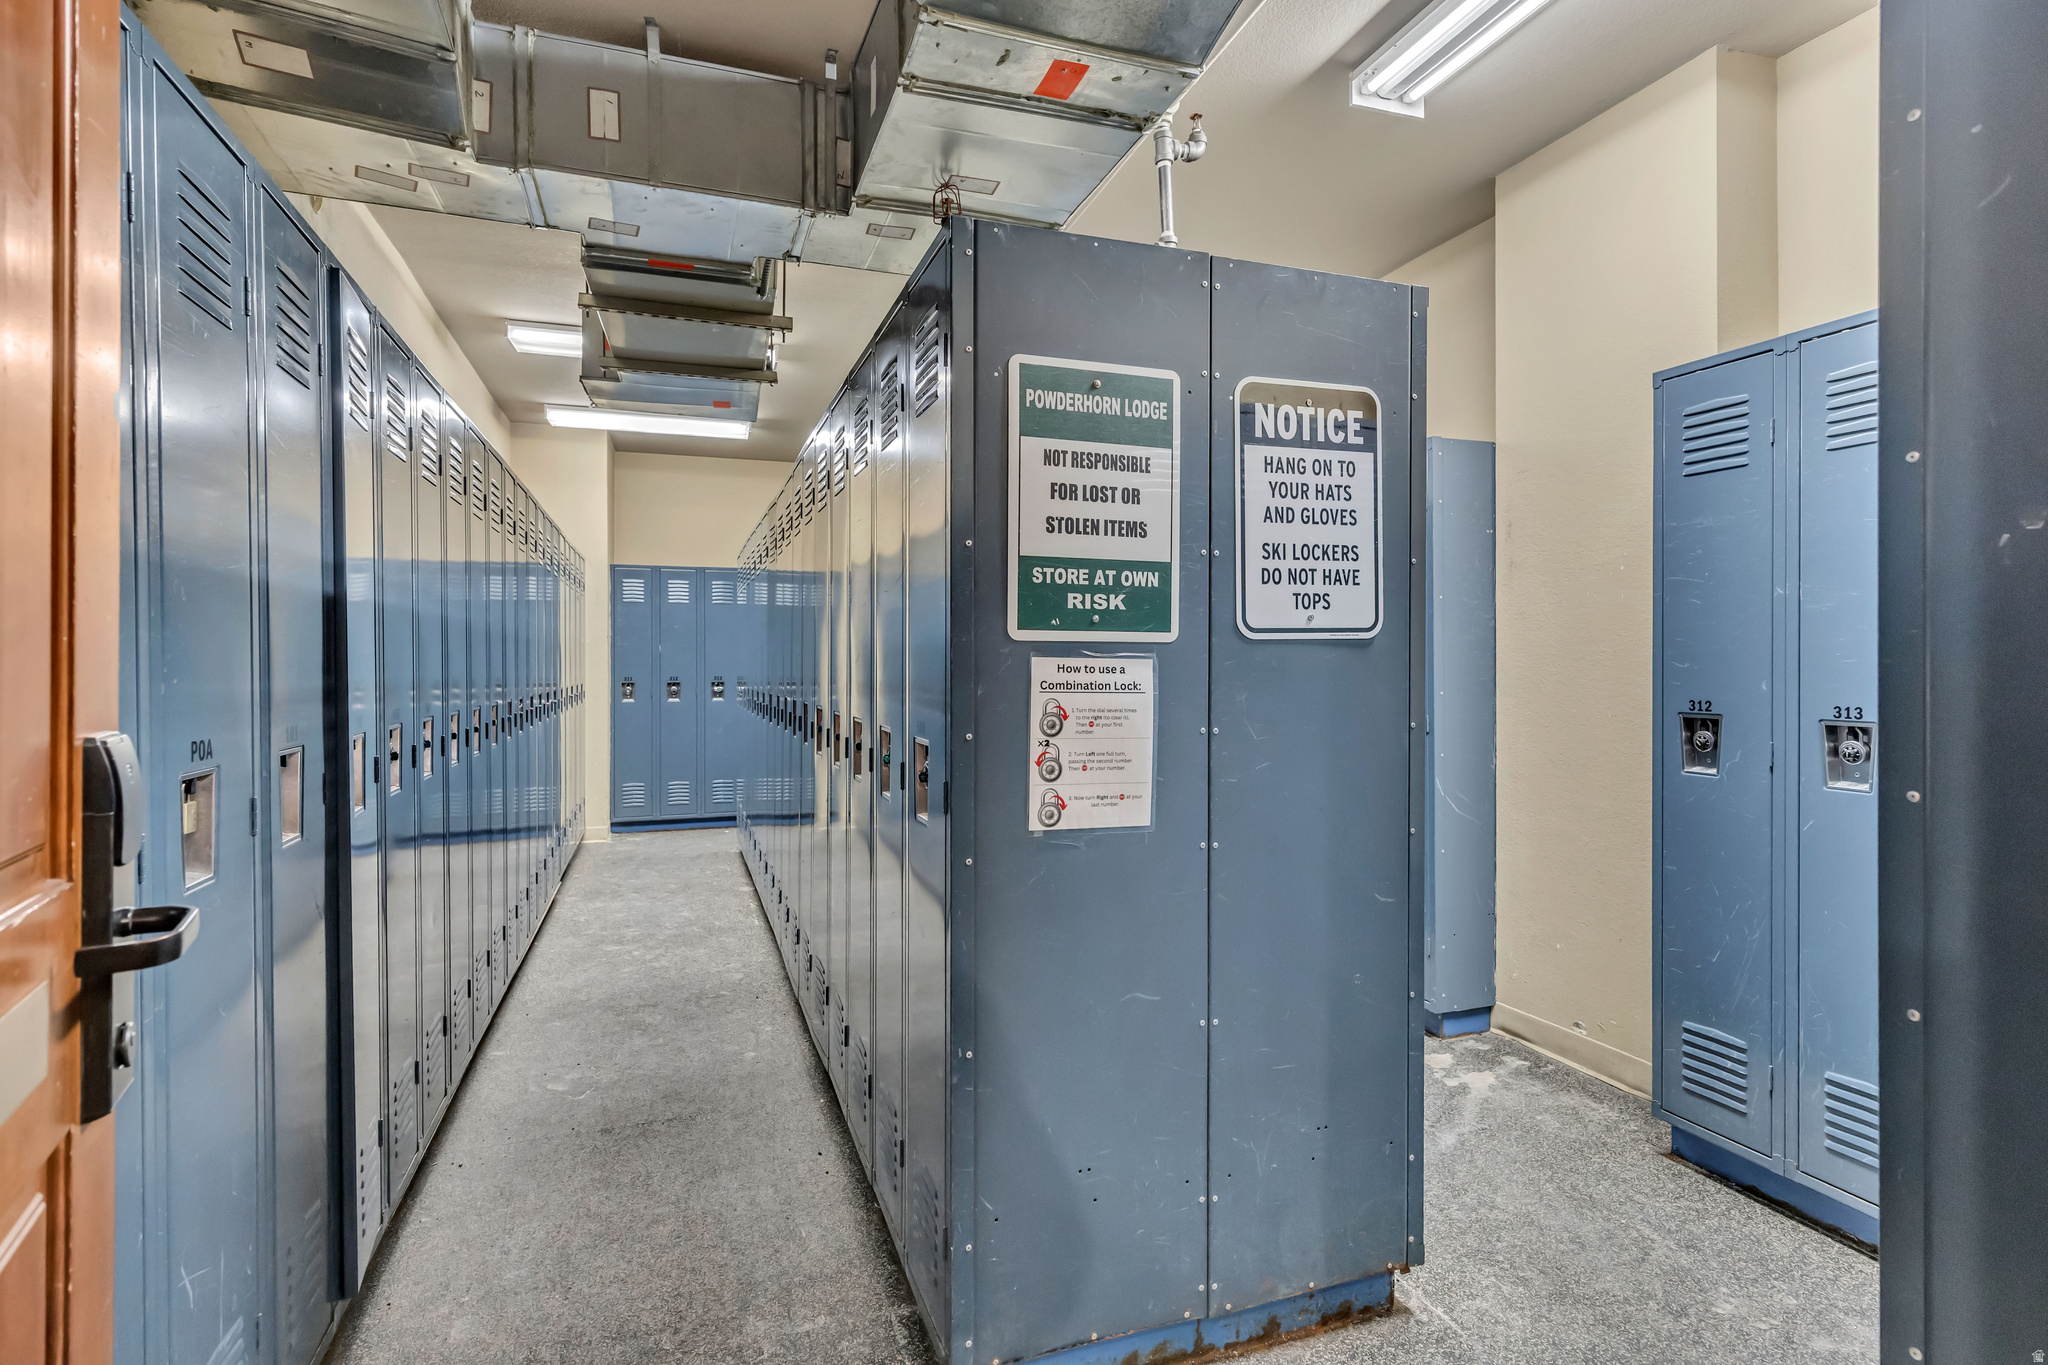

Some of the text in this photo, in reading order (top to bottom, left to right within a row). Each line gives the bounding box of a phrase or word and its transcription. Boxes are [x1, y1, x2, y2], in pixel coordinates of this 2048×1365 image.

[1026, 388, 1168, 420] POWDERHORN LODGE
[1254, 402, 1364, 444] NOTICE
[1044, 448, 1150, 474] NOT RESPONSIBLE
[1264, 456, 1356, 478] HANG ON TO
[1050, 482, 1140, 505] FOR LOST OR
[1268, 481, 1352, 502] YOUR HATS
[1264, 506, 1357, 526] AND GLOVES
[1046, 516, 1148, 538] STOLEN ITEMS
[1262, 542, 1359, 562] SKI LOCKERS
[1032, 567, 1158, 587] STORE AT OWN
[1262, 568, 1360, 586] DO NOT HAVE
[1068, 592, 1126, 610] RISK
[1292, 593, 1330, 610] TOPS
[1058, 664, 1081, 674] How
[1084, 665, 1096, 674] to
[1040, 681, 1142, 691] Combination Lock:
[1688, 700, 1712, 712] 312
[1833, 706, 1864, 720] 313
[191, 739, 212, 762] POA
